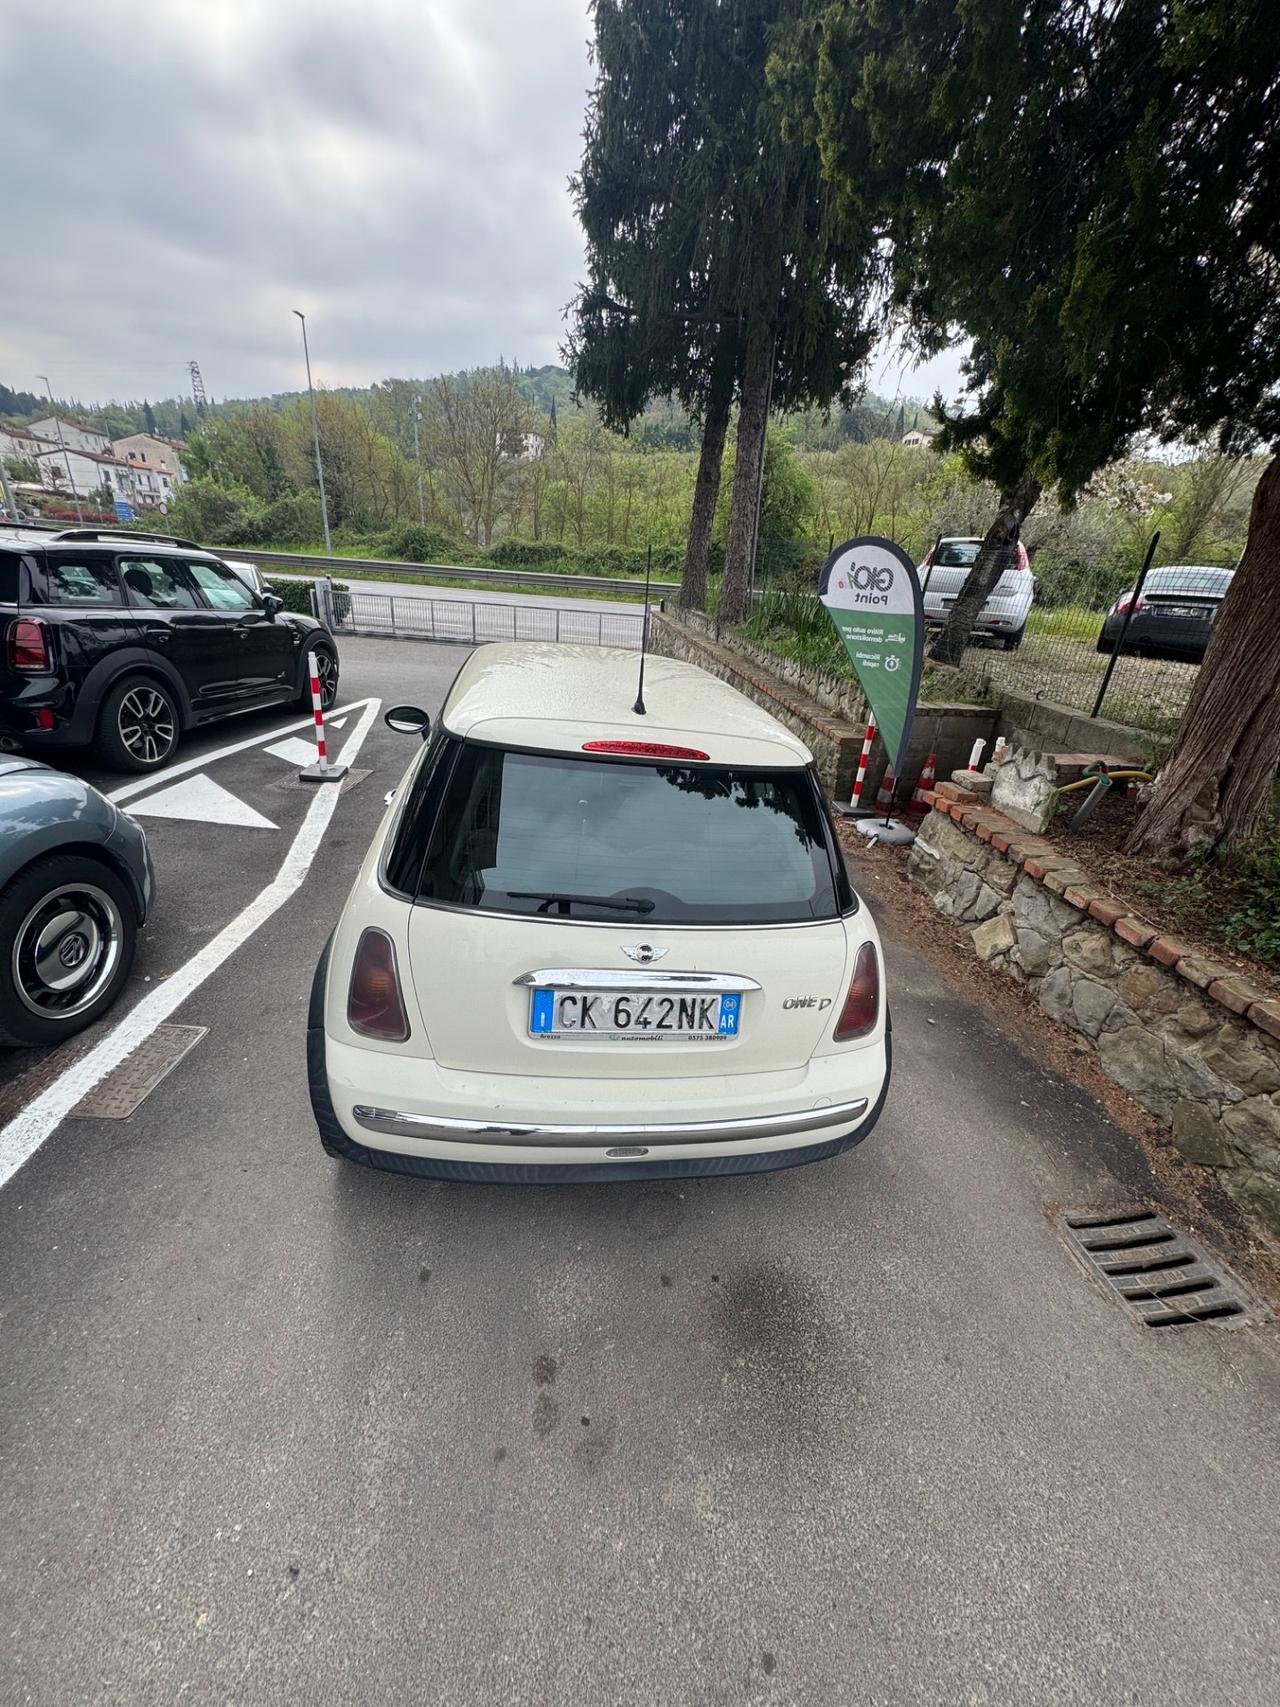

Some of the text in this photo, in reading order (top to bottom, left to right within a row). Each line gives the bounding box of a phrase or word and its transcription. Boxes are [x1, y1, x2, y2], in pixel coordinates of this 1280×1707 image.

[782, 994, 832, 1011] ONE D
[559, 996, 599, 1028] CK
[613, 995, 718, 1031] 642NK
[720, 1014, 734, 1029] AR
